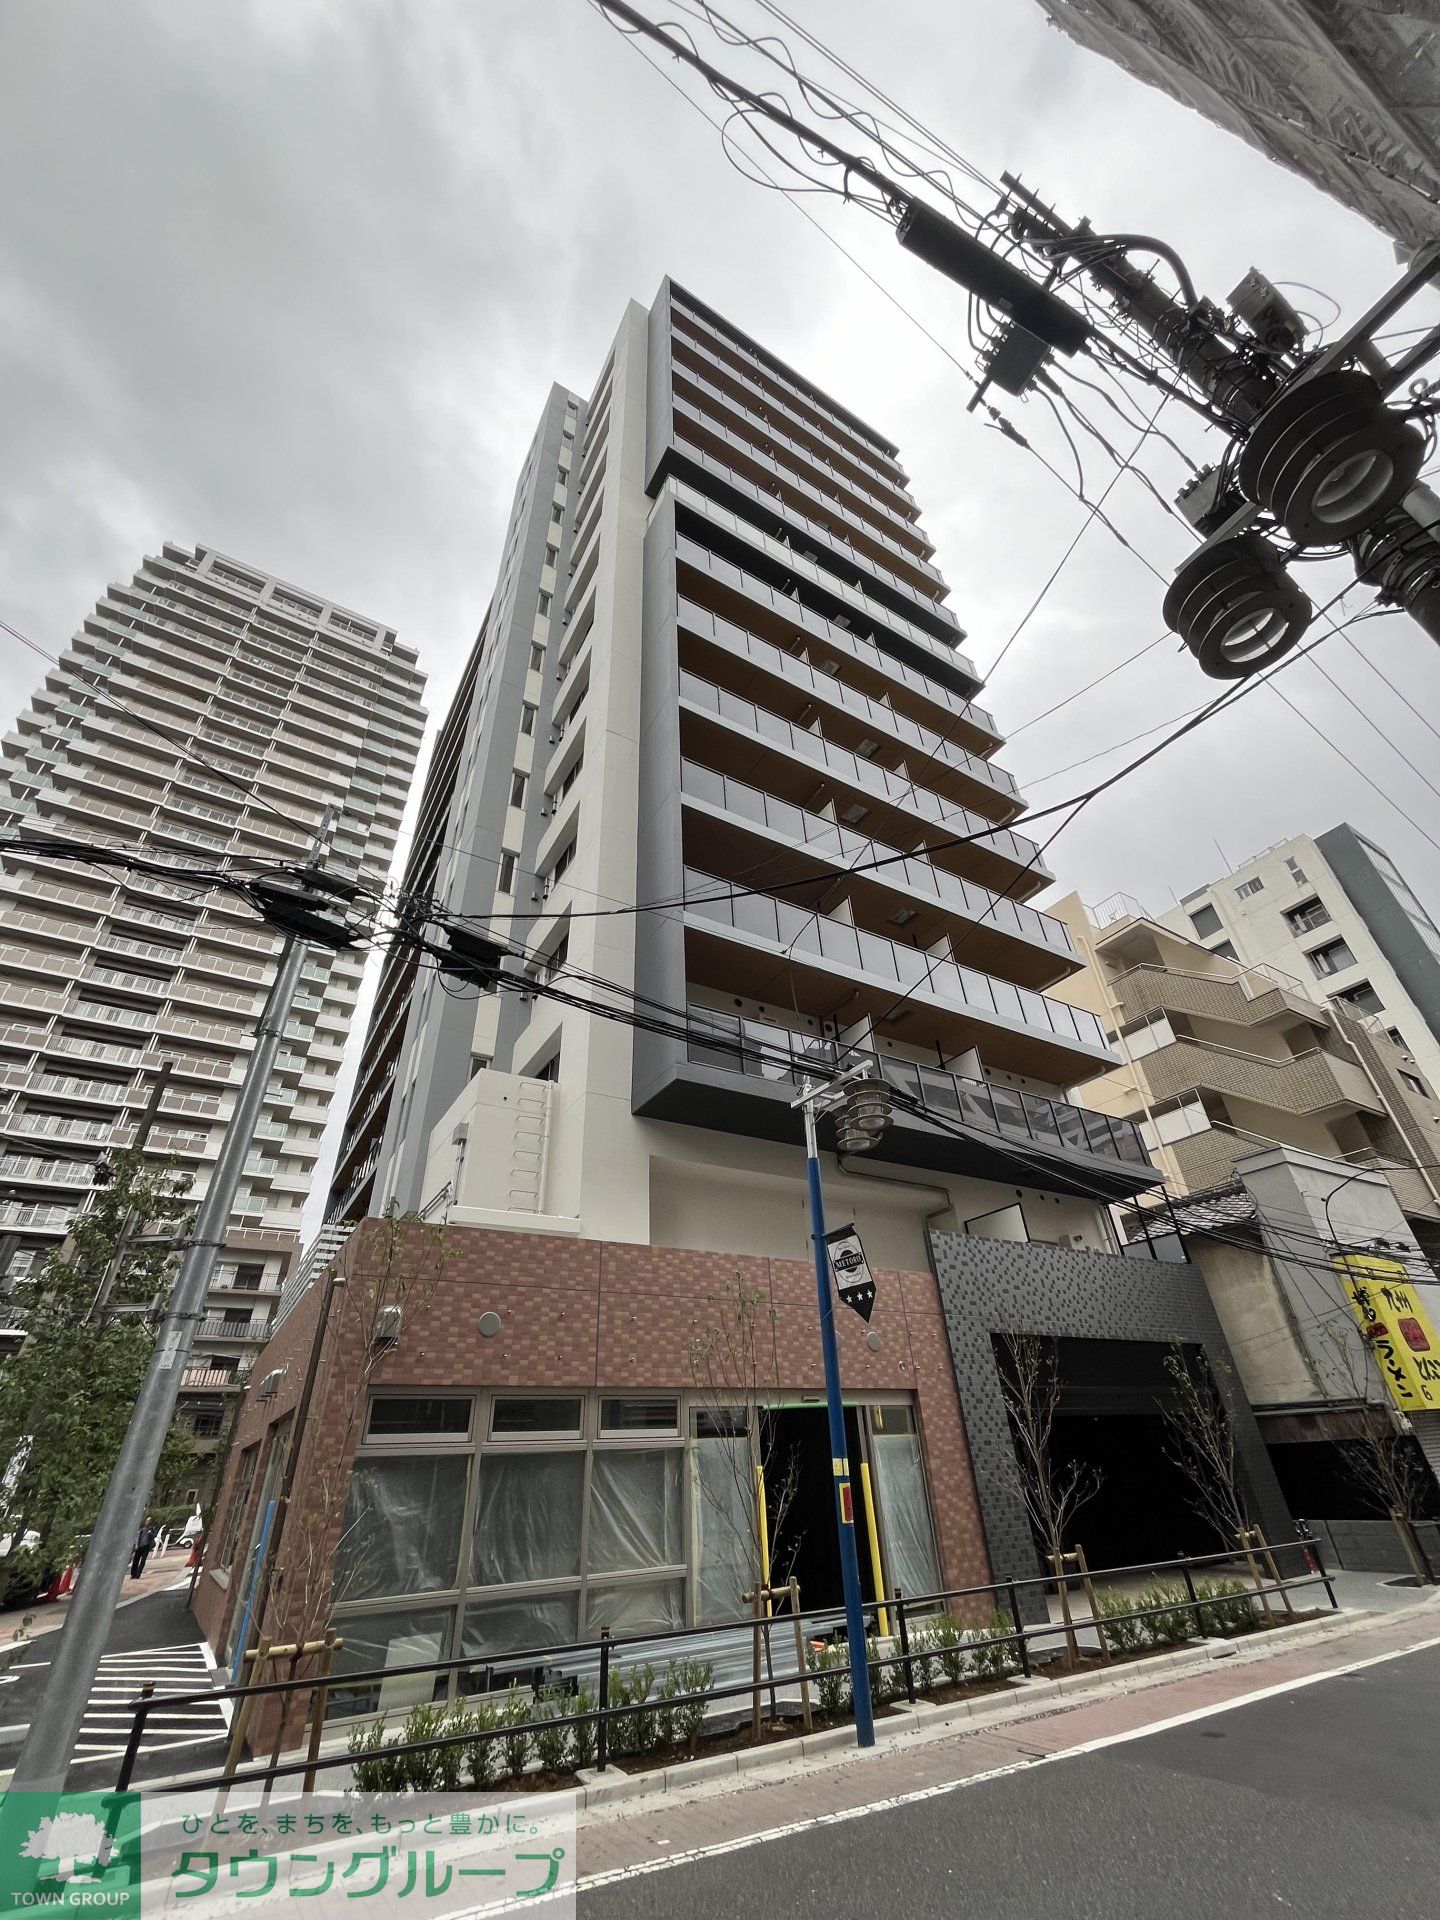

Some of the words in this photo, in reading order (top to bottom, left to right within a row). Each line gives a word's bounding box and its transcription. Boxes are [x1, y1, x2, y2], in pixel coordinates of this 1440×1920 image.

[1381, 1285, 1413, 1314] 九州
[1375, 1339, 1413, 1397] ラーメン
